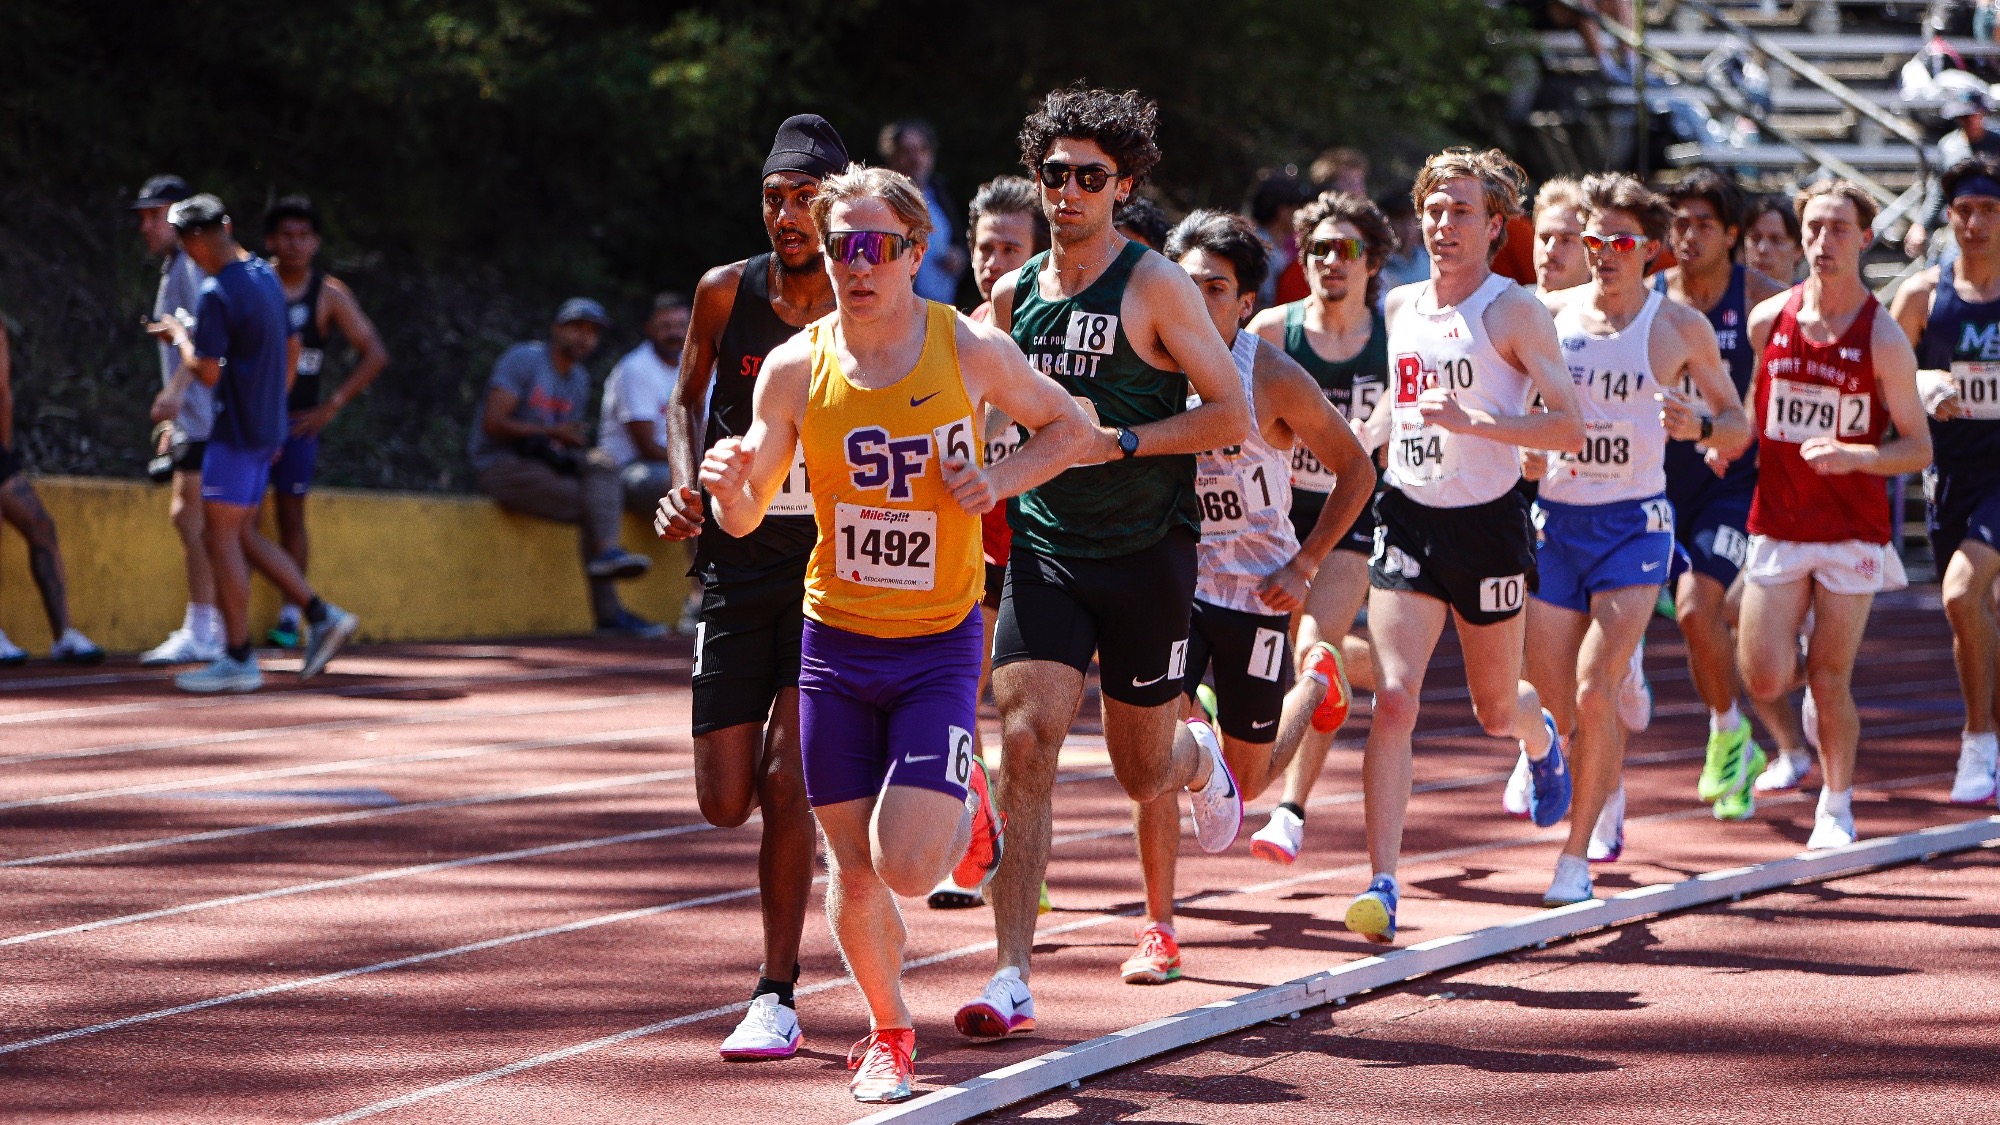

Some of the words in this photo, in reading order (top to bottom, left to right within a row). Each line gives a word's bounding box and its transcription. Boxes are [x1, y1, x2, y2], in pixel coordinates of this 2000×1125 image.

[1033, 335, 1047, 346] CAL
[1050, 335, 1066, 346] POL
[1077, 314, 1108, 351] 18
[740, 355, 762, 378] ST
[1024, 352, 1101, 378] MBOLDT
[1444, 357, 1473, 390] 10
[1601, 369, 1629, 402] 14
[1776, 397, 1834, 429] 1679
[1847, 399, 1866, 431] 2
[947, 423, 969, 463] 6
[1400, 435, 1444, 467] 754
[1560, 437, 1630, 464] 003
[844, 425, 933, 502] SF
[1251, 465, 1271, 507] 1
[859, 508, 910, 524] MileSplit
[840, 525, 931, 569] 1492
[1490, 579, 1519, 609] 10
[1264, 635, 1278, 677] 1
[955, 734, 970, 784] 6
